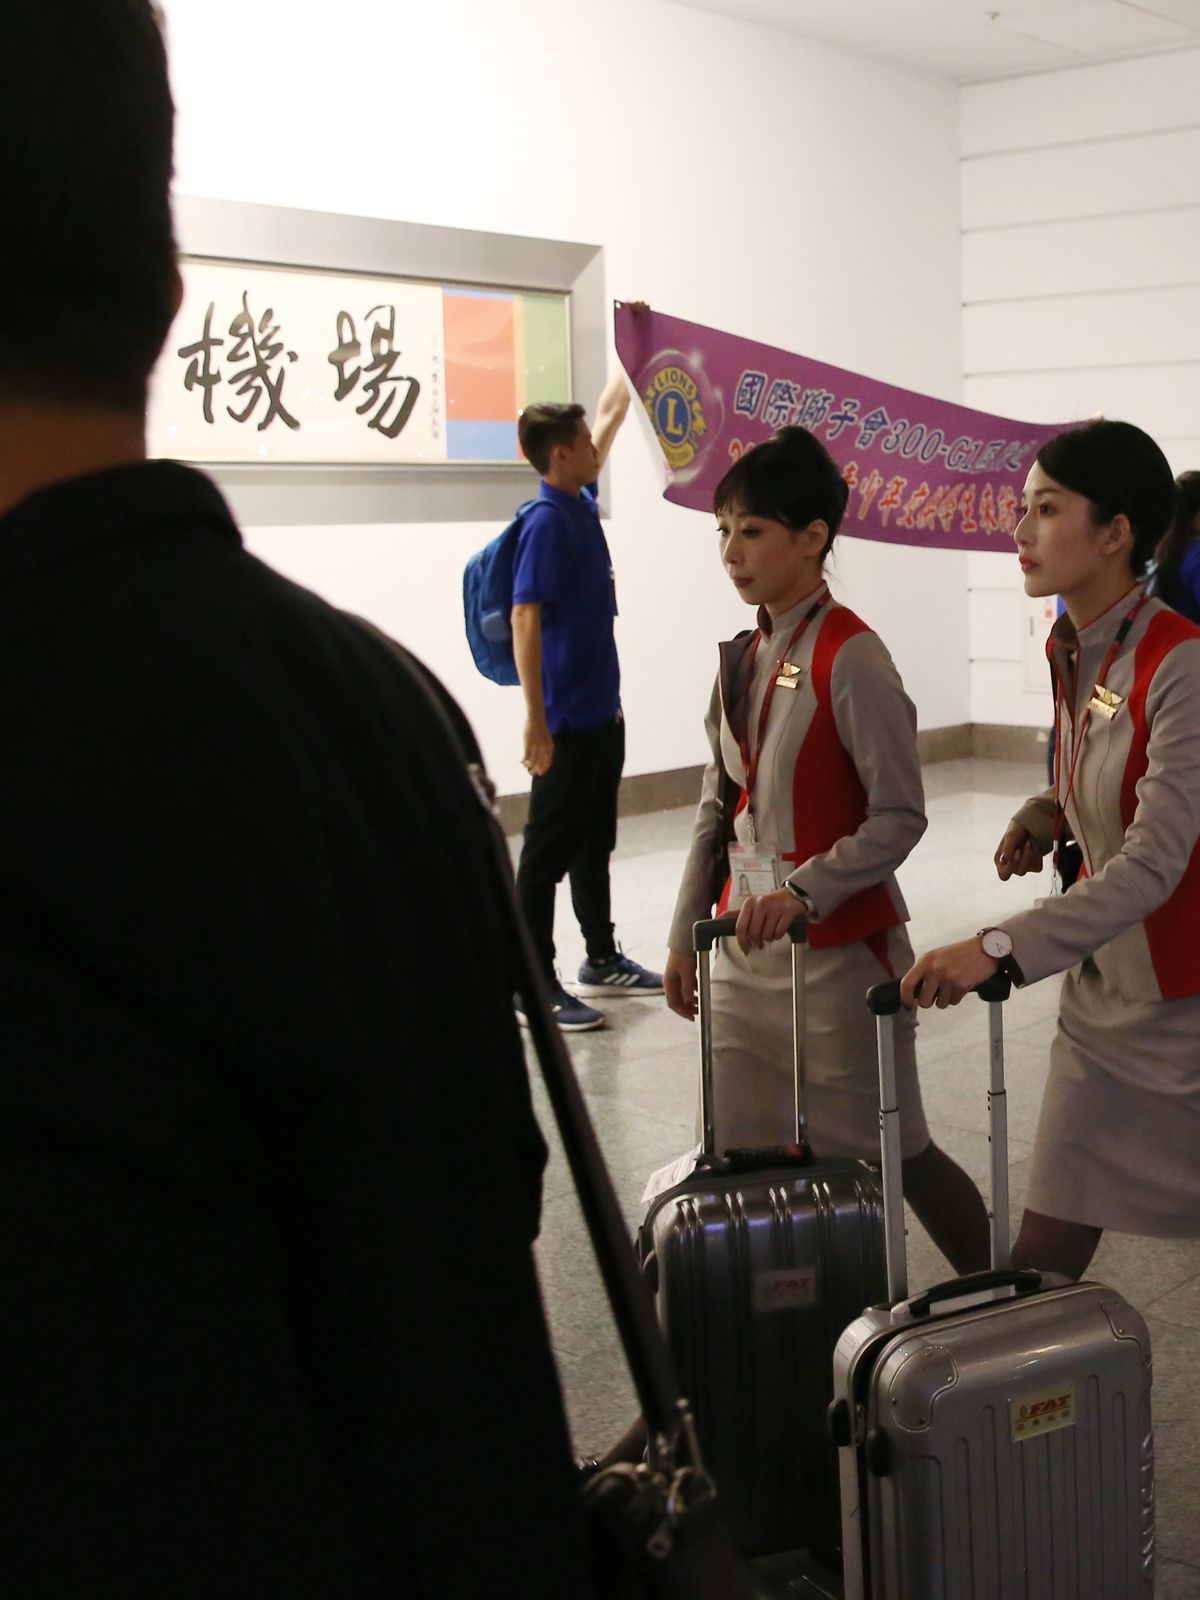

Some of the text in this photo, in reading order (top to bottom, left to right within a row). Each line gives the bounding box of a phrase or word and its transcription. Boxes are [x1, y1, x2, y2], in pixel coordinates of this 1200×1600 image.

[178, 290, 421, 439] 機場
[657, 369, 697, 396] LIONS
[666, 398, 683, 435] L
